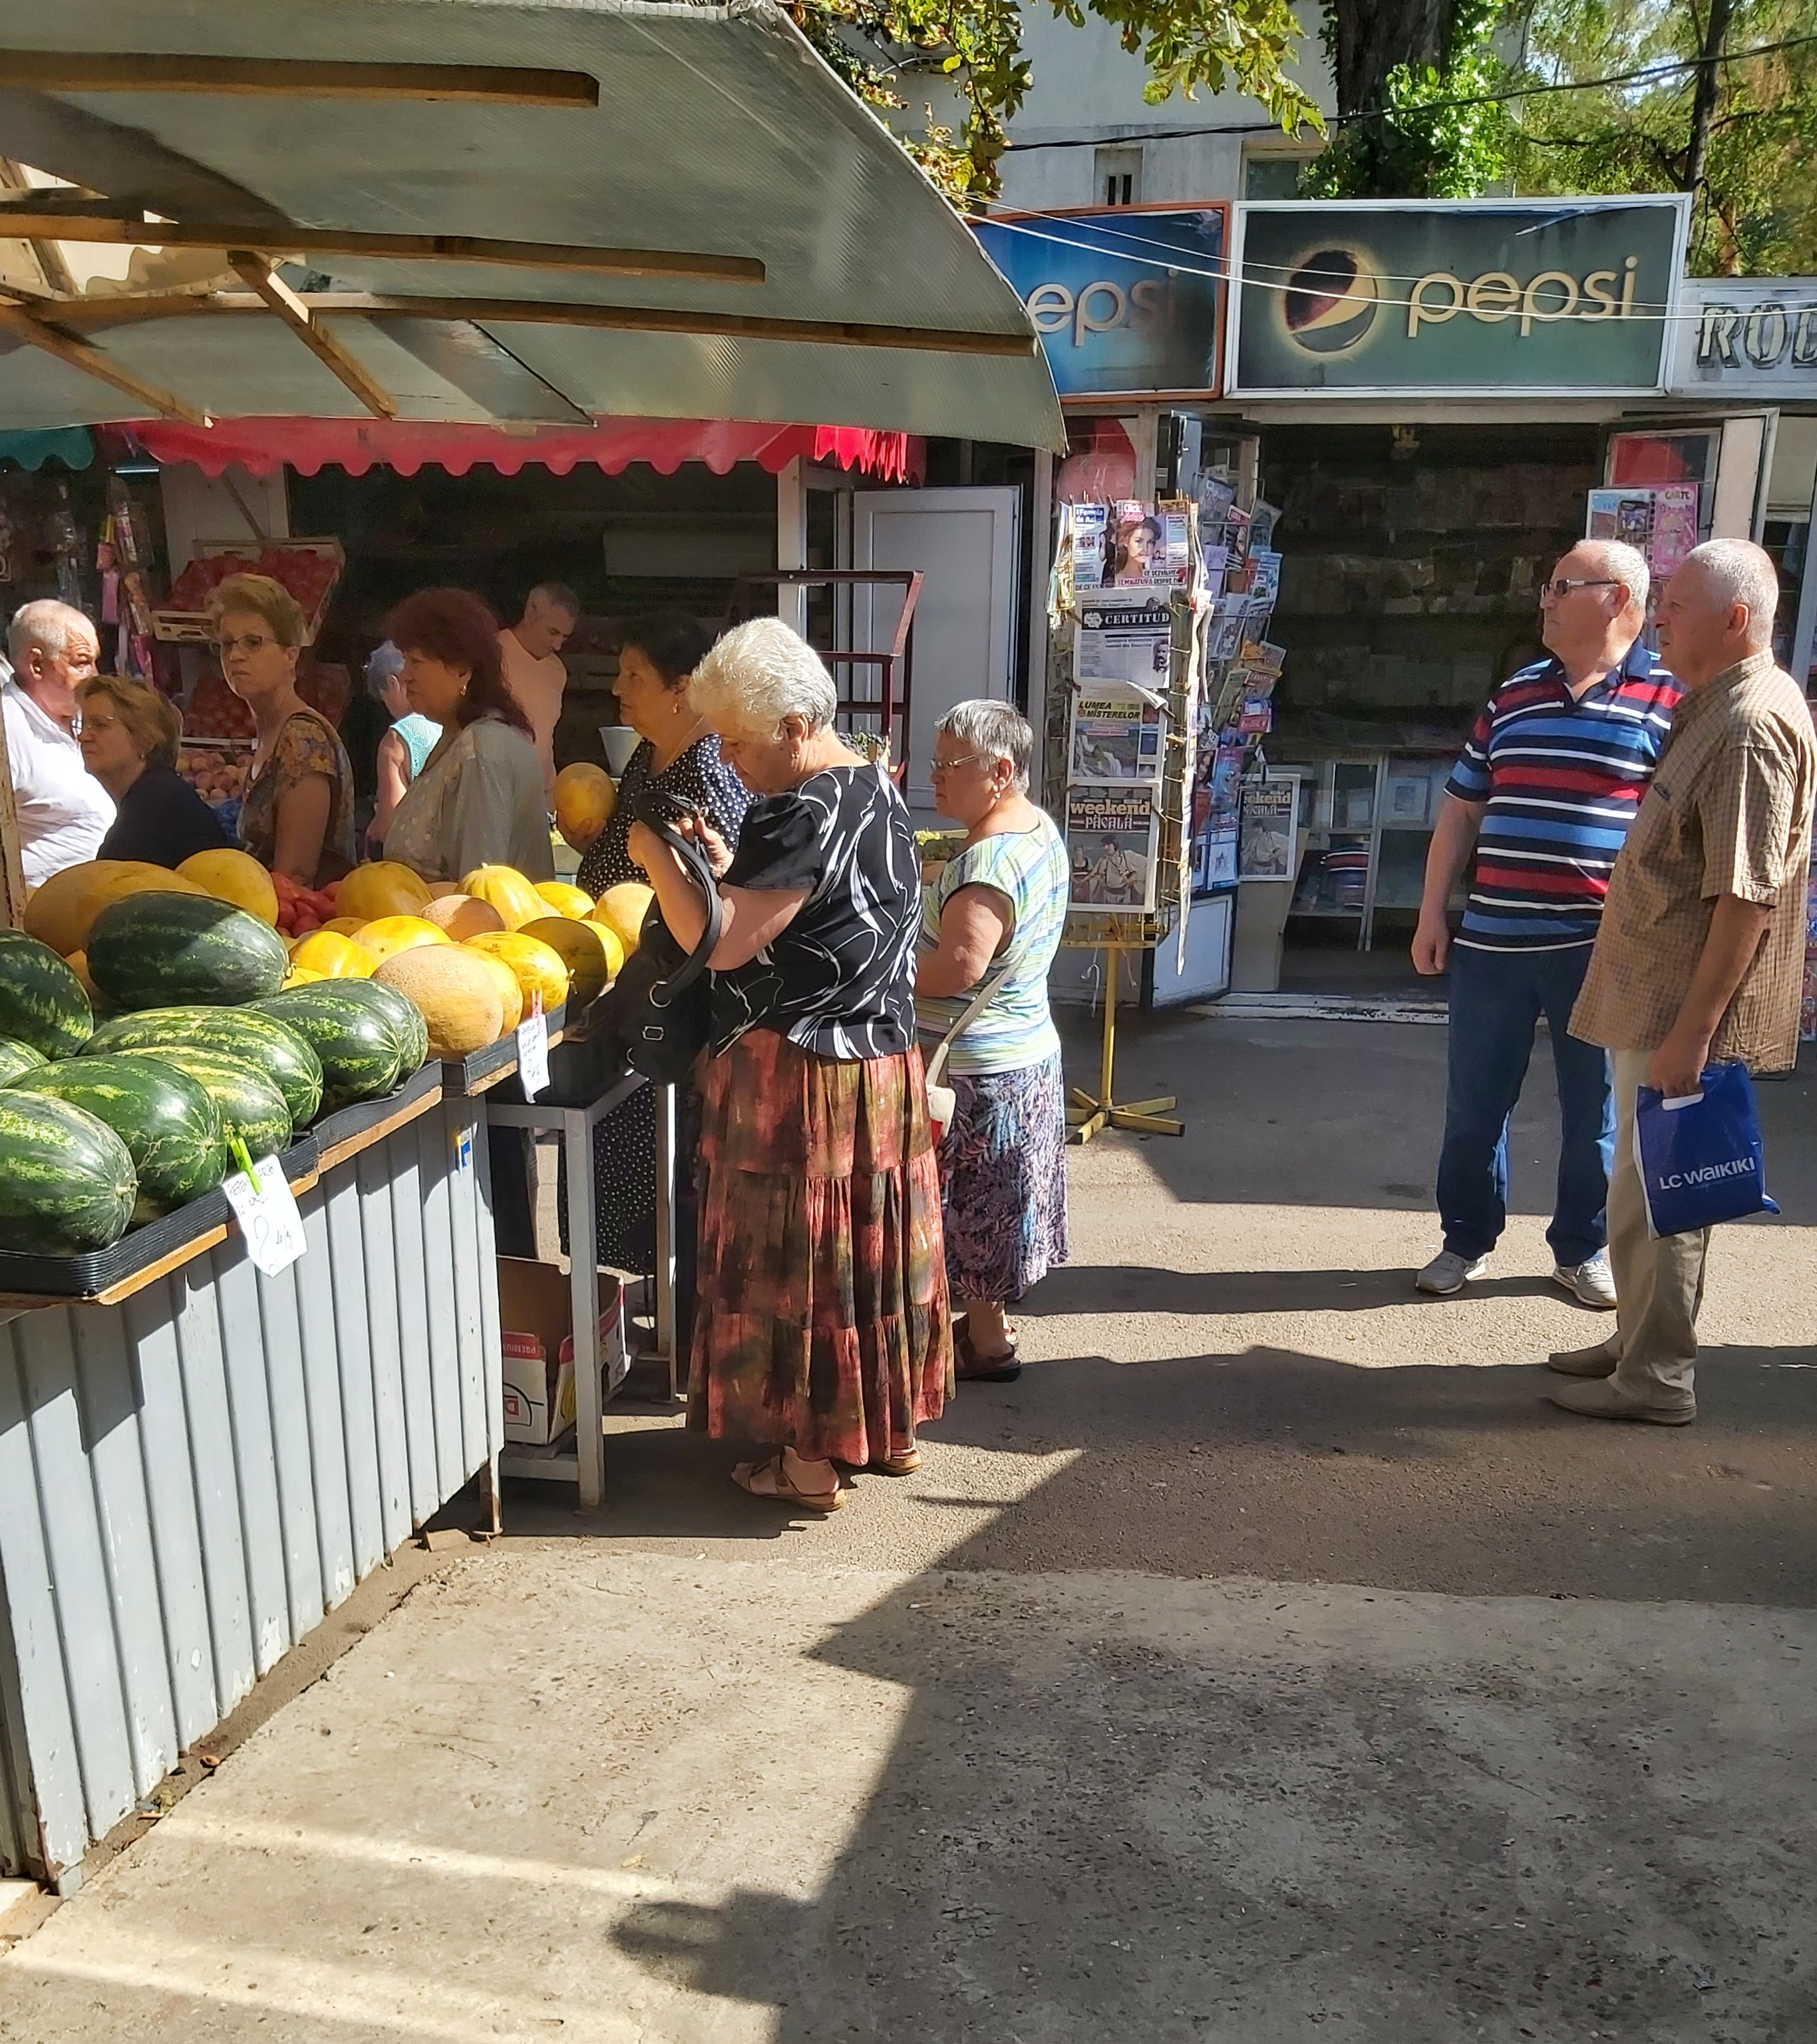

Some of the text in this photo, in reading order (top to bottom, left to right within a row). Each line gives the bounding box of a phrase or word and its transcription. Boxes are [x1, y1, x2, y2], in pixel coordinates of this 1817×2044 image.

[1408, 255, 1637, 337] pepsi
[1027, 268, 1179, 346] epsi
[1104, 613, 1170, 625] CERTITUD
[1086, 709, 1140, 719] MISTERELOR
[1070, 799, 1151, 815] weekend
[1659, 1175, 1683, 1189] LC
[506, 1344, 537, 1354] PREMIU
